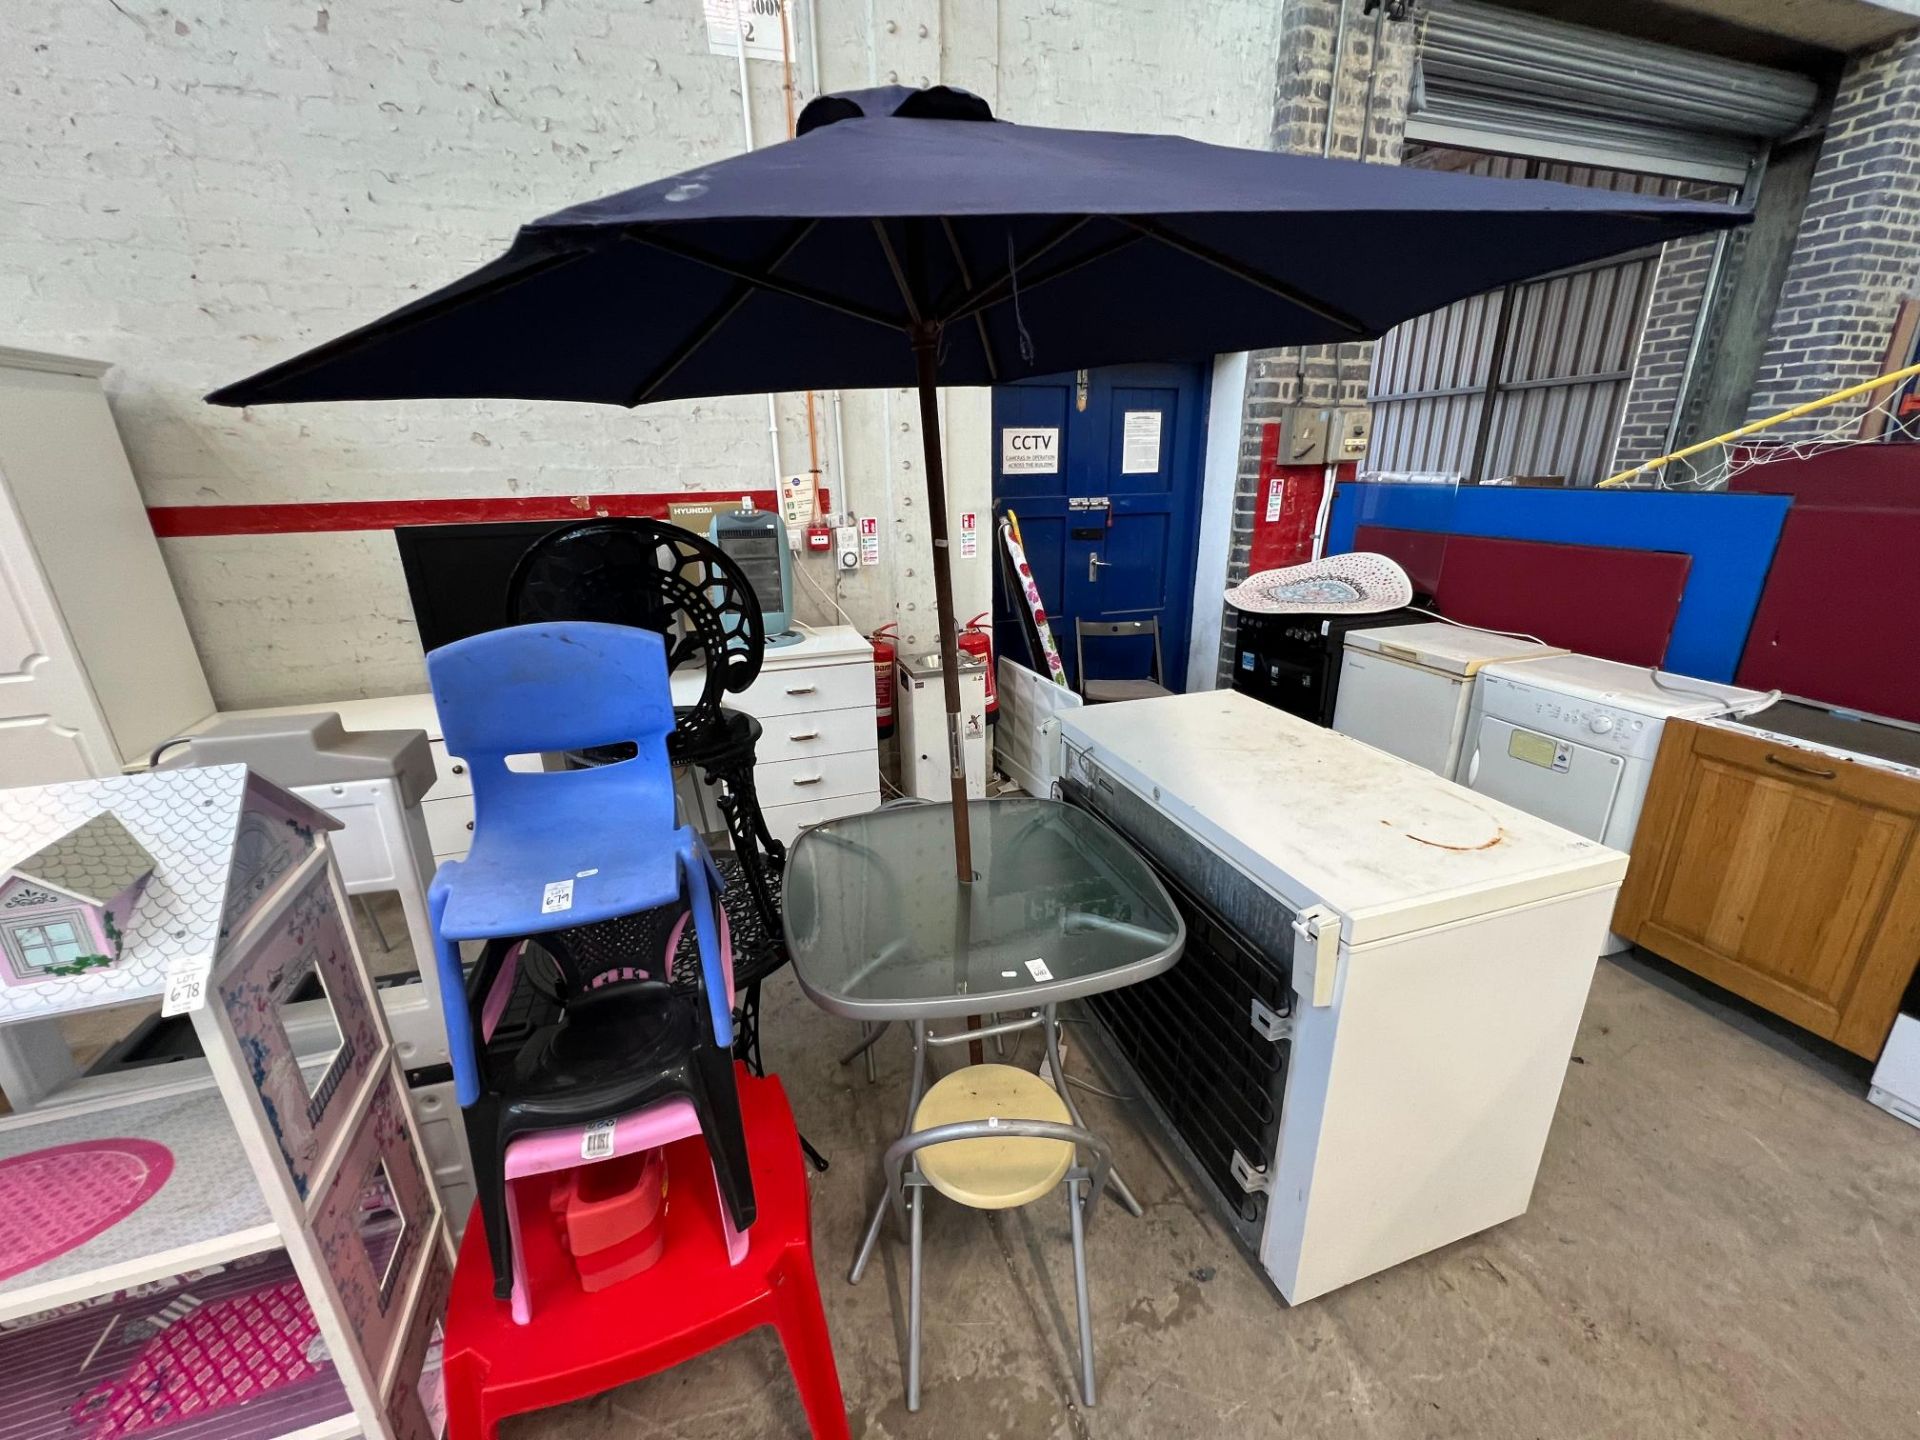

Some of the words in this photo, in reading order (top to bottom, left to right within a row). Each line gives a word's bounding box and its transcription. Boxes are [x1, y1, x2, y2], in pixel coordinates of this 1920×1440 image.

[745, 21, 755, 42] 2
[1012, 435, 1052, 450] CCTV
[673, 506, 713, 515] HYUNDAI
[875, 664, 891, 672] oam
[546, 893, 569, 906] 679
[176, 973, 196, 984] LOT
[170, 981, 200, 1002] 678
